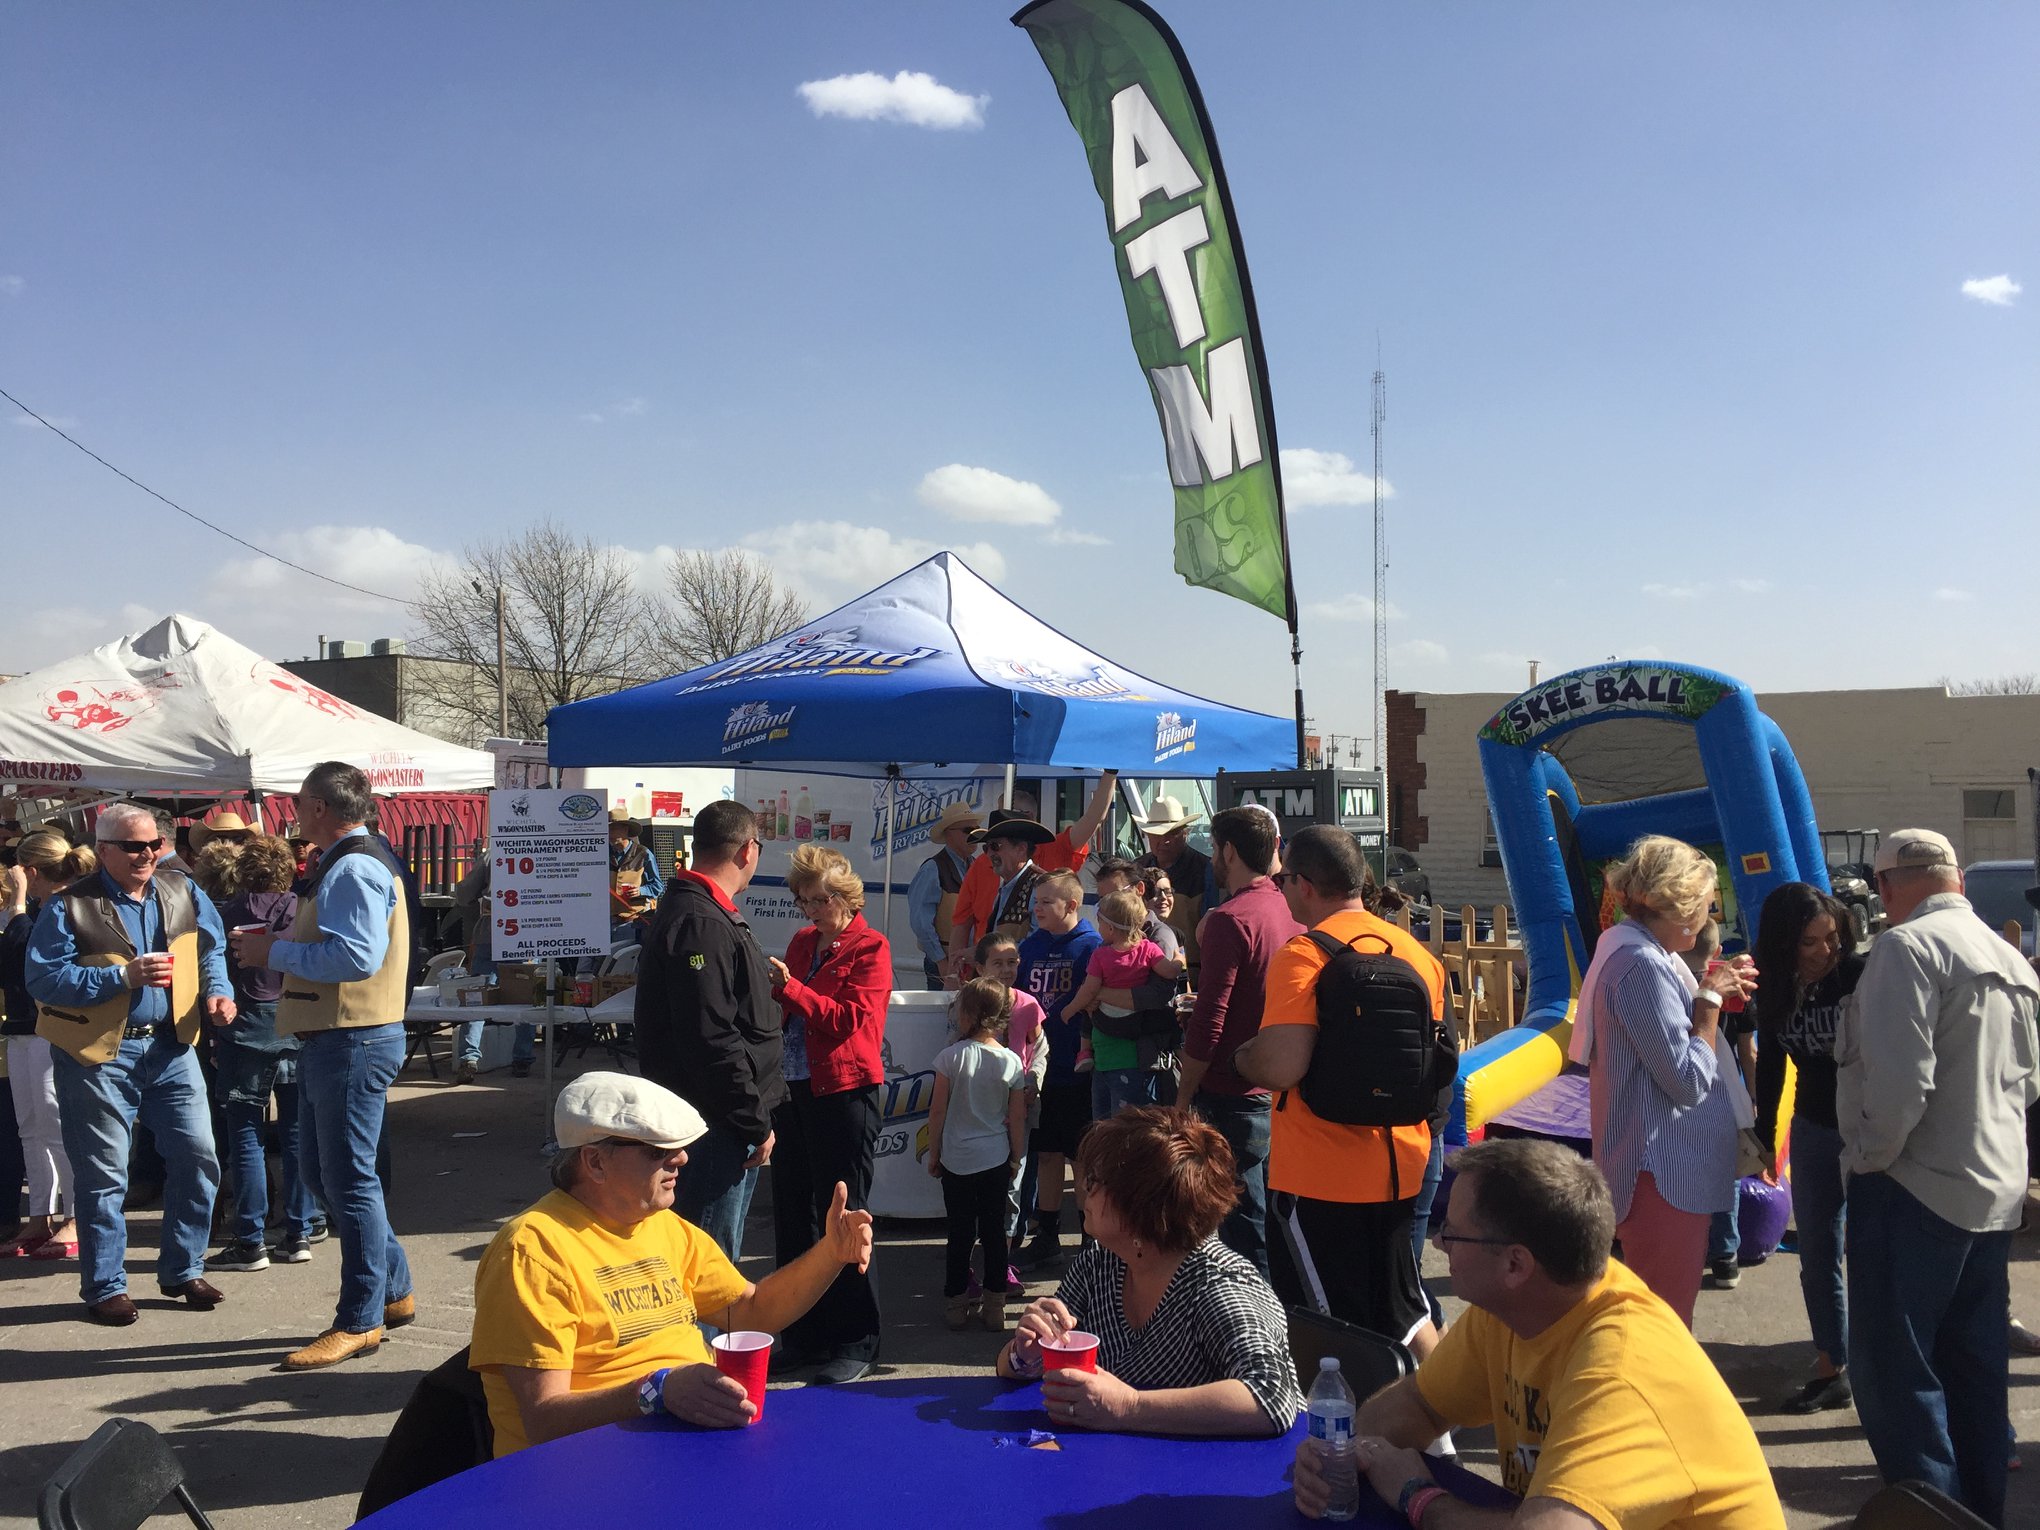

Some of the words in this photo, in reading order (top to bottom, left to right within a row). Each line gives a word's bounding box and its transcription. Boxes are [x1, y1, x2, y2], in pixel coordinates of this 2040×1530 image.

[1109, 82, 1263, 487] ATM
[703, 646, 941, 681] Hiland
[1016, 666, 1130, 698] Hiland
[1507, 681, 1588, 732] SKEE
[1595, 673, 1686, 705] BALL
[723, 705, 797, 742] Hiland
[721, 740, 744, 755] DAIRY
[743, 733, 768, 747] FOODS
[1155, 719, 1197, 751] Hiland
[368, 751, 415, 764] WICHITA
[364, 768, 425, 787] AGONMASTERS
[874, 778, 982, 841] Hiland
[1239, 789, 1314, 817] ATM
[1344, 788, 1374, 816] ATM
[497, 825, 546, 833] WAGONMASTERS
[495, 840, 532, 848] WICHITA
[534, 838, 606, 847] WAGONMASTERS
[1360, 834, 1381, 847] MONEY
[503, 846, 564, 855] TOURNAMENT
[565, 845, 598, 853] SPECIAL
[496, 857, 535, 875] $10
[496, 889, 519, 907] $8
[745, 896, 767, 906] First
[768, 898, 777, 907] in
[754, 908, 775, 918] First
[777, 909, 786, 918] in
[496, 918, 519, 936] $5
[502, 950, 535, 959] Benefit
[536, 949, 561, 957] Local
[562, 946, 602, 956] Charities
[517, 941, 535, 949] ALL
[536, 938, 586, 948] PROCEEDS
